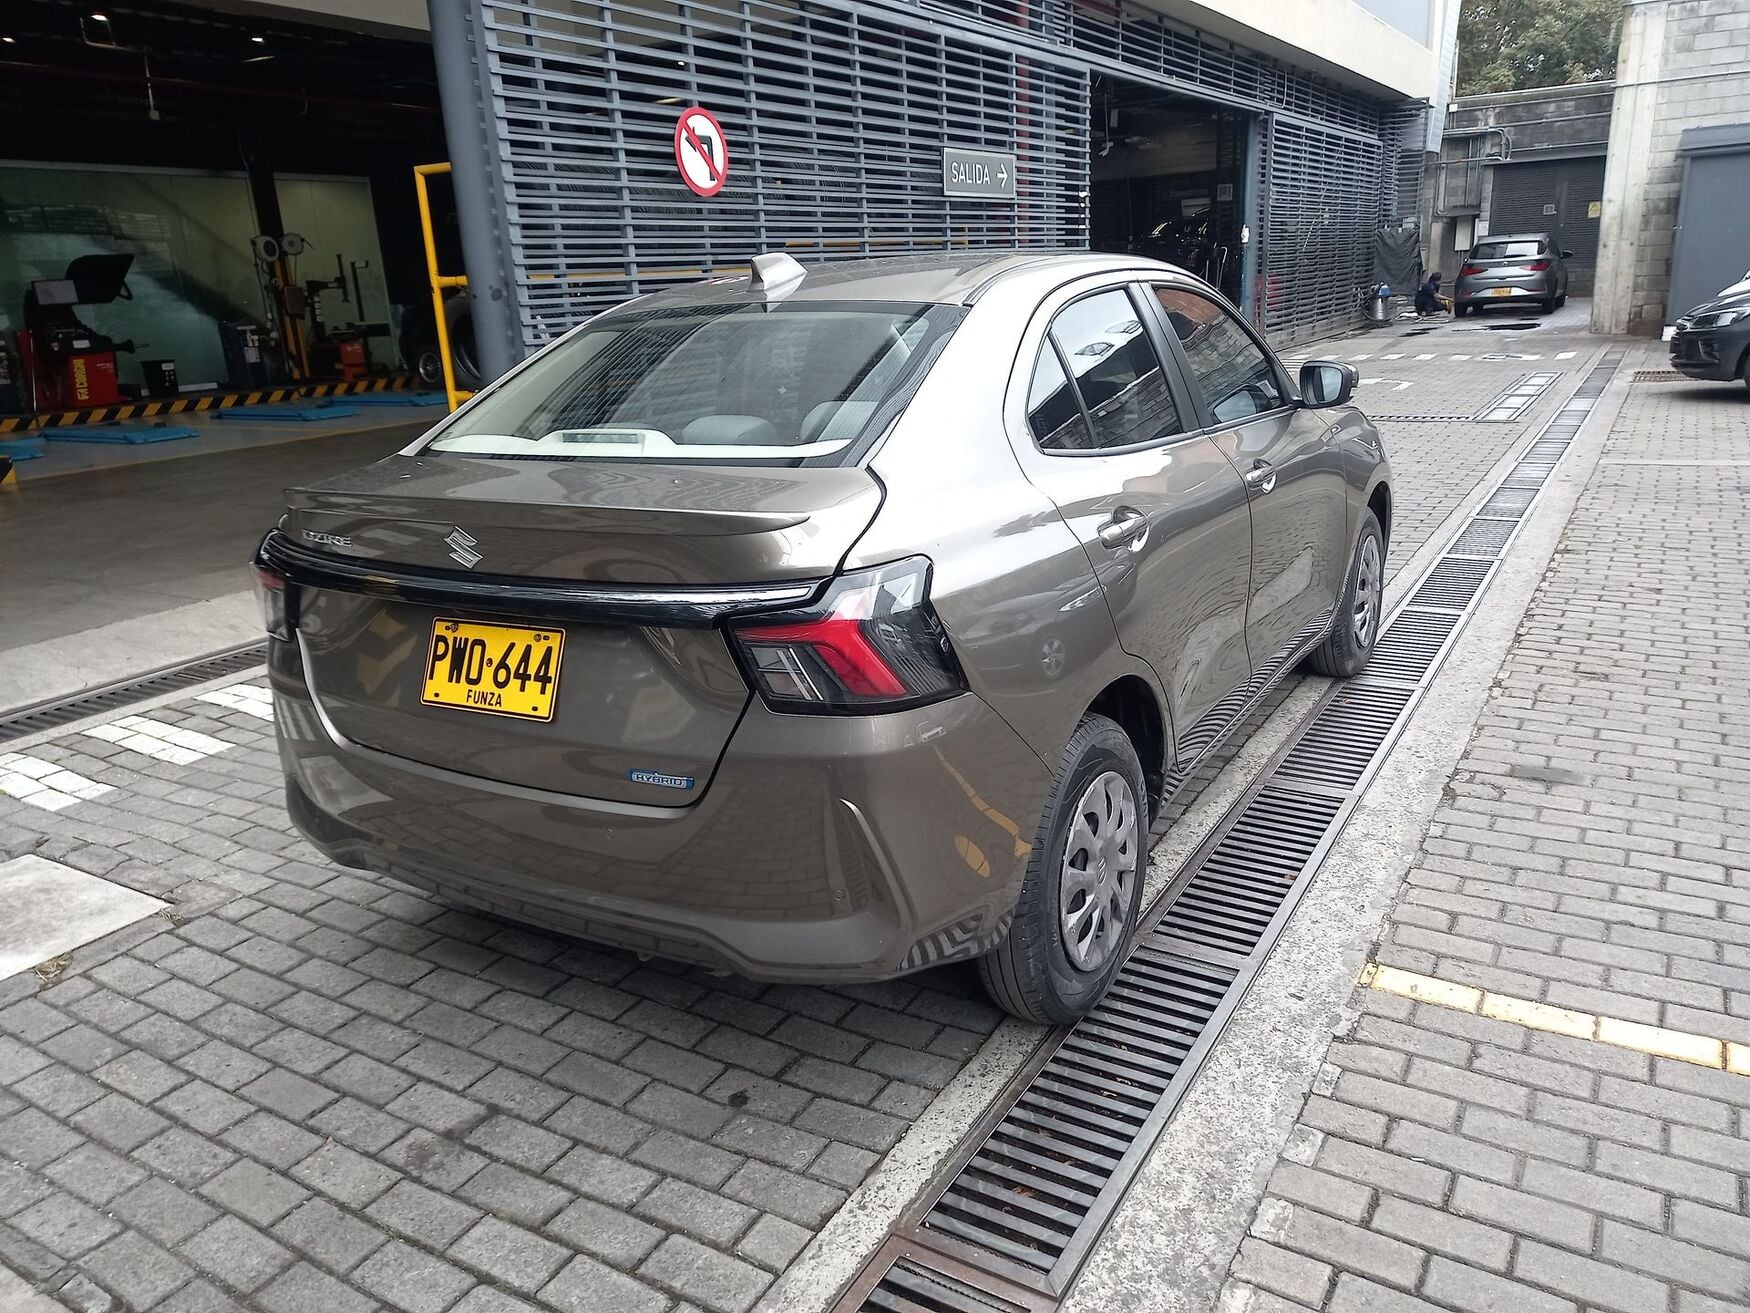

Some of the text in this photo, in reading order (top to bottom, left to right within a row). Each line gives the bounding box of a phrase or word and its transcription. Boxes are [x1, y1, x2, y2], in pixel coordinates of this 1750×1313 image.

[951, 161, 991, 185] SALIDA
[466, 689, 503, 708] FUNZA
[636, 773, 682, 786] HYBRID
